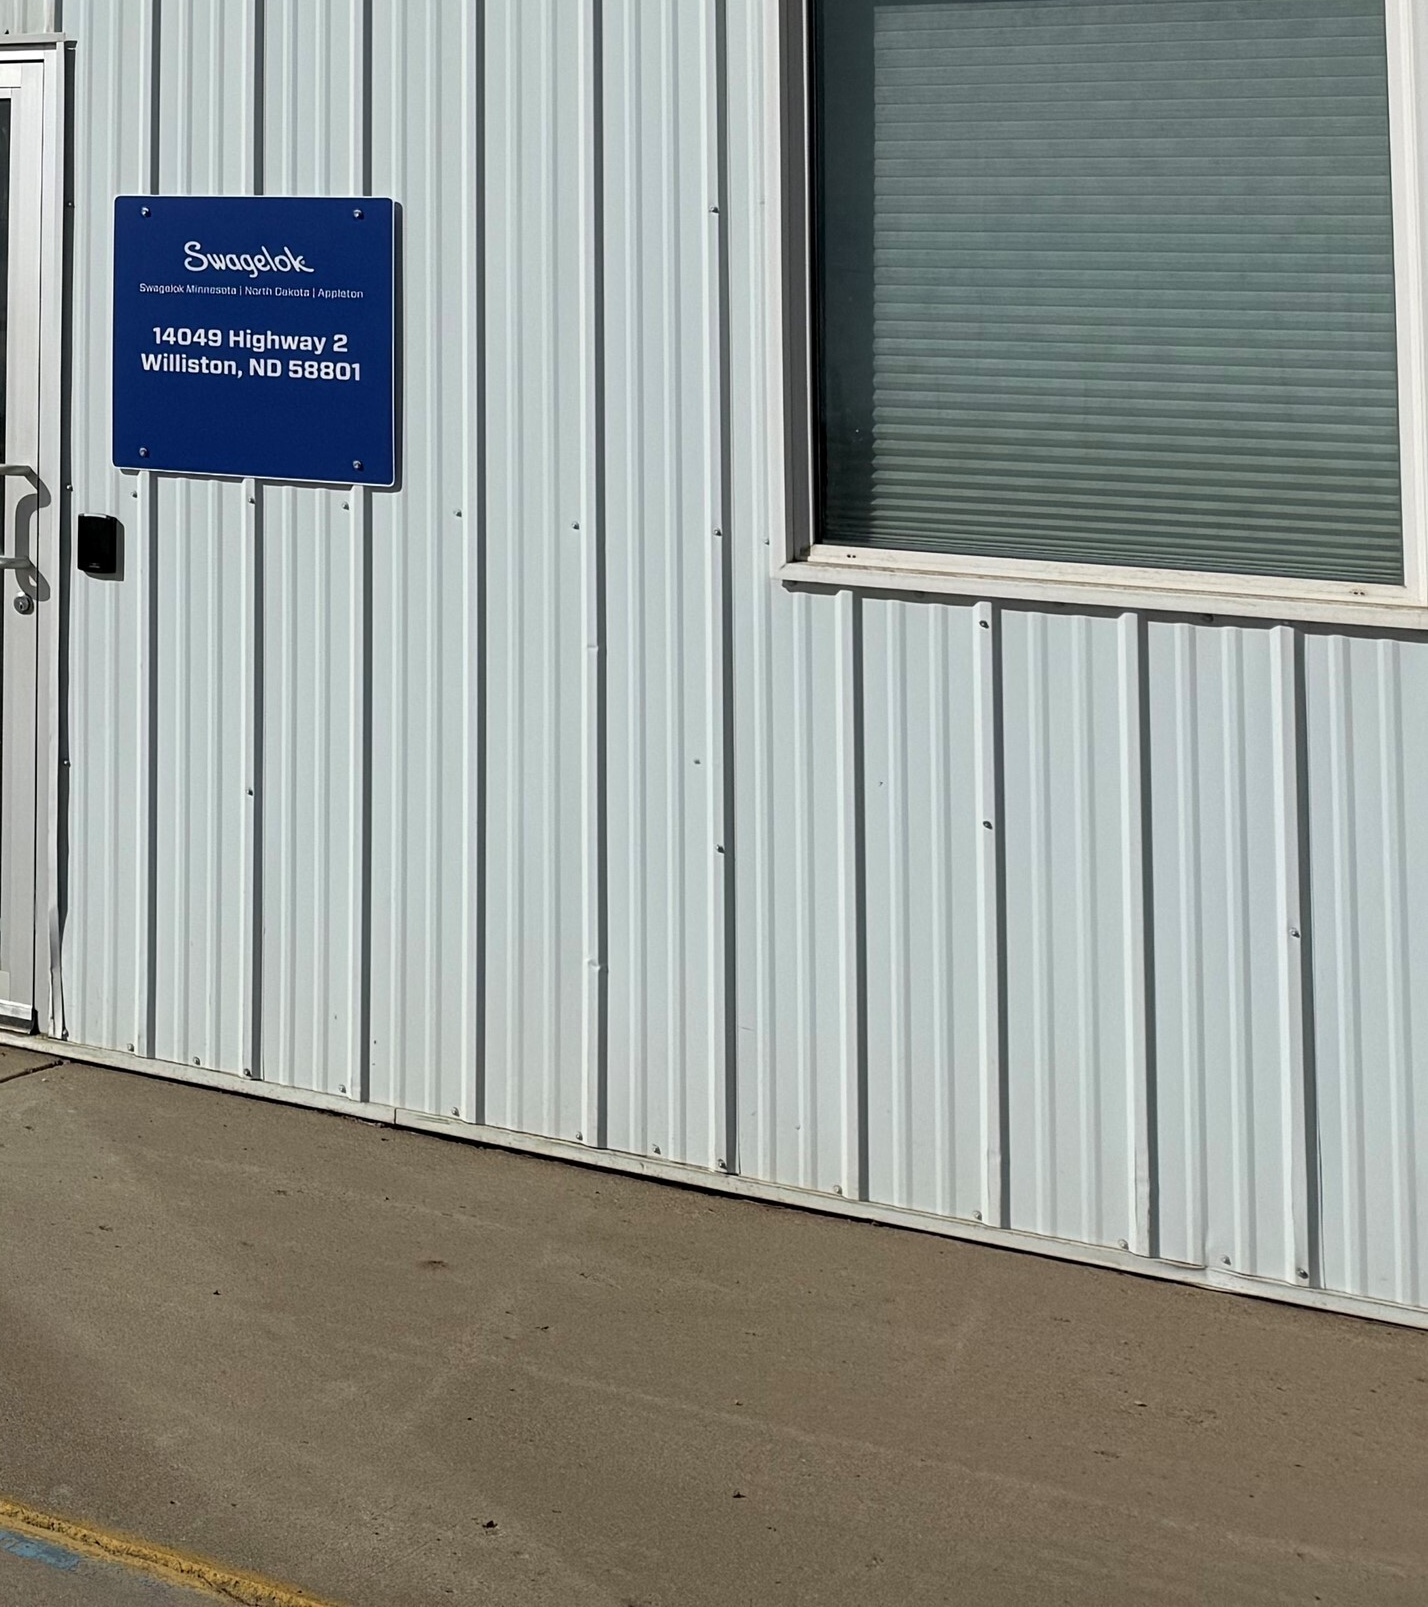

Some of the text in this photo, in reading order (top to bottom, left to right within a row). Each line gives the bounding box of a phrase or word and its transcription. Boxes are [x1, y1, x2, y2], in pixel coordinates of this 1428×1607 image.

[184, 240, 315, 278] Swagelok
[139, 282, 185, 295] Swagelok
[186, 283, 237, 296] Minnesota
[245, 285, 273, 296] North
[275, 286, 310, 298] Dakota
[317, 288, 364, 299] Appleton
[152, 327, 349, 355] 14049 Highway 2
[140, 353, 361, 381] Williston, ND 58801
